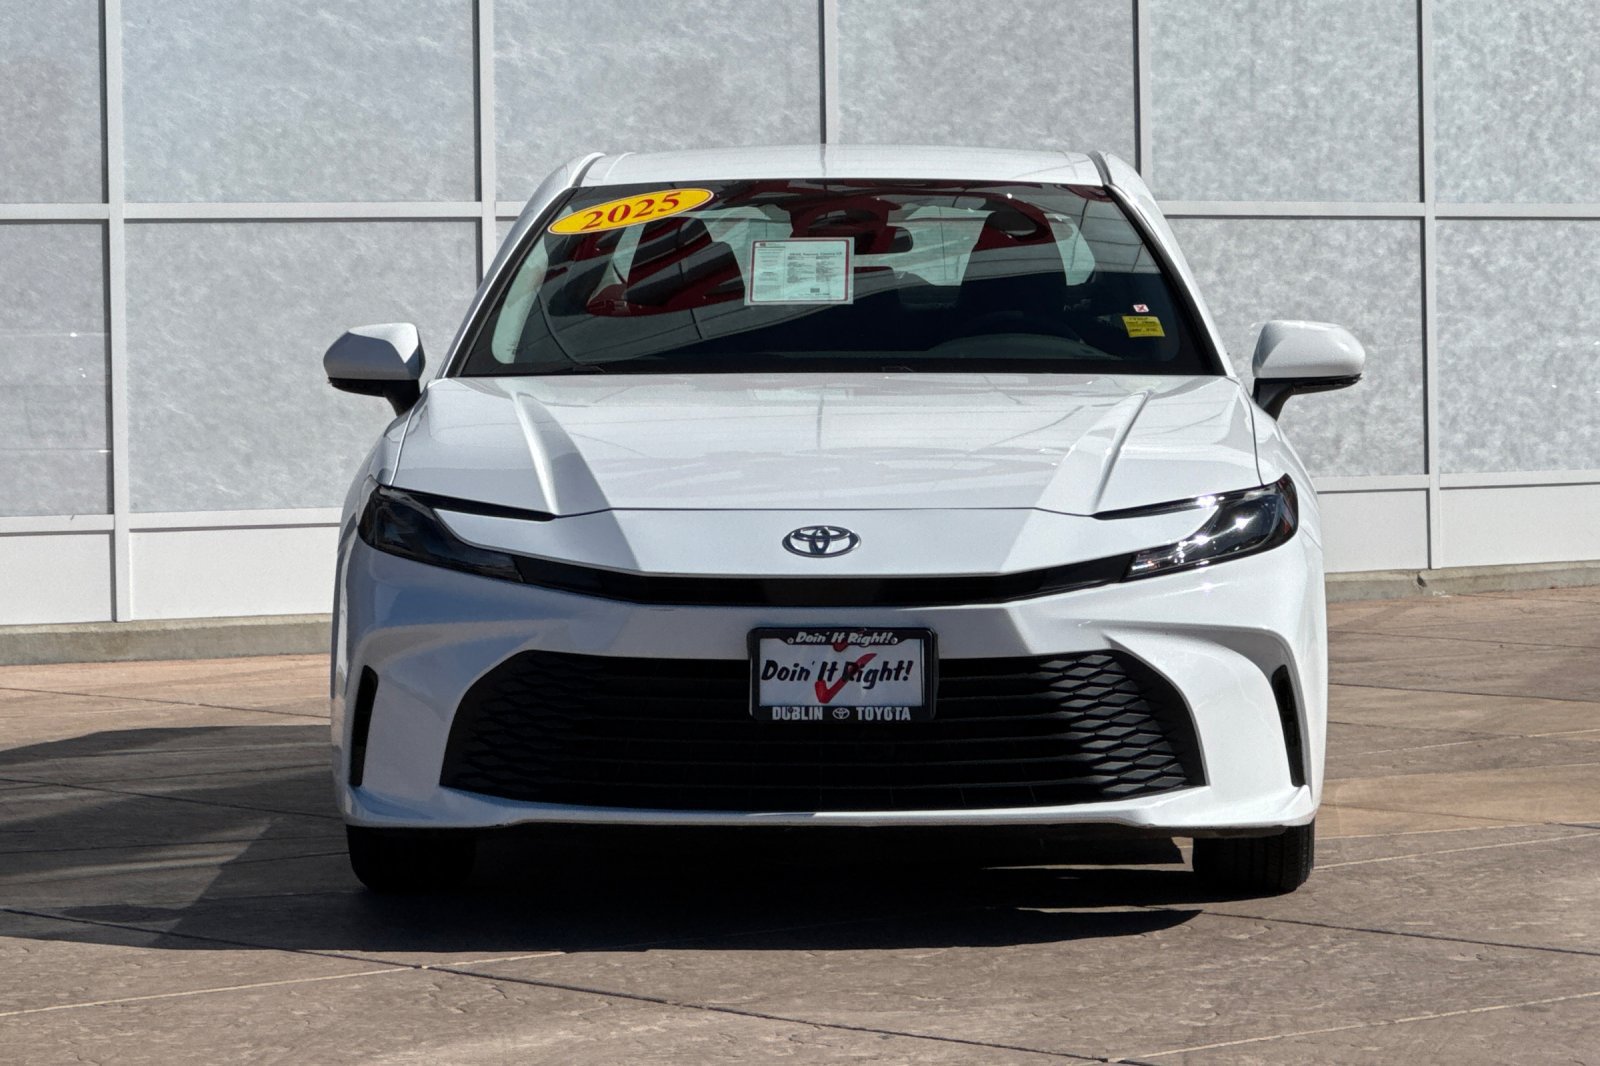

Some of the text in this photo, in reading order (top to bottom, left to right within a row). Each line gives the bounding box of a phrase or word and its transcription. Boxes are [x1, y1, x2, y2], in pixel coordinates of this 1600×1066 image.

[580, 192, 681, 231] 2025
[795, 632, 892, 647] Doin' It Right!
[761, 660, 914, 690] Doin' It Right!
[772, 707, 911, 721] DUBLIN TOYOTA
